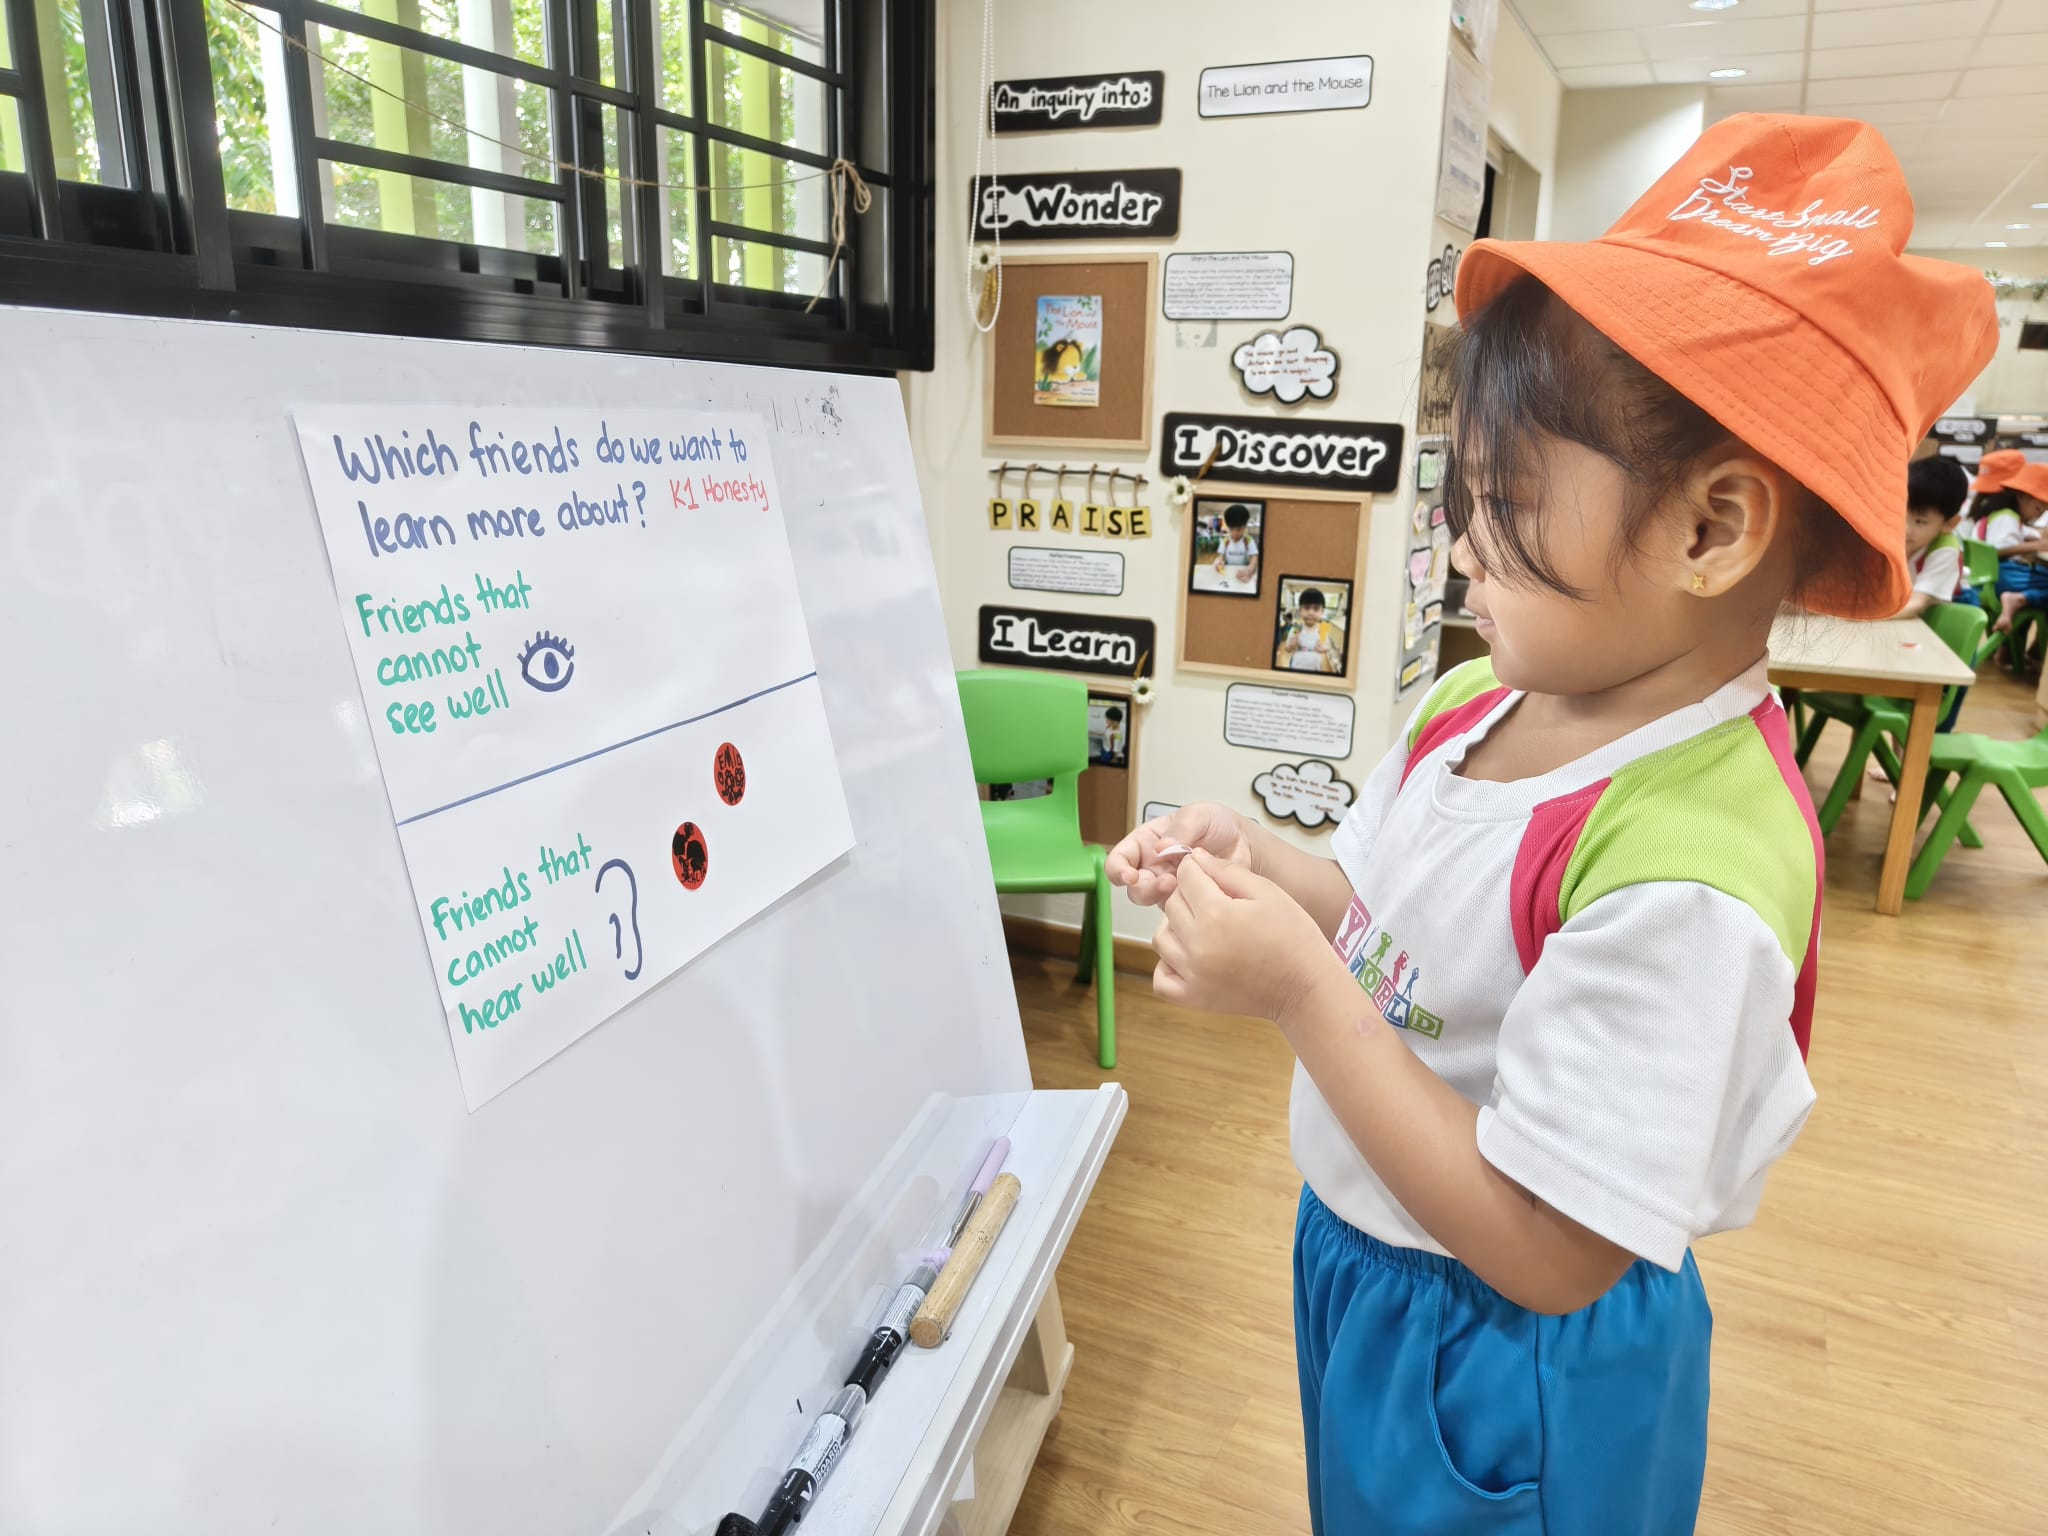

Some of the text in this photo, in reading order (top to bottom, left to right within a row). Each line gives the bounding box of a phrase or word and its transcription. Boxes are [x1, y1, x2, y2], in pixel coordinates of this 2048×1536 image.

[997, 82, 1149, 117] An inquiry into:
[1207, 76, 1363, 99] The Lion and the Mouse
[984, 184, 1159, 224] I Wonder
[1666, 188, 1854, 266] Dream Big
[333, 421, 748, 485] Which friends do we want to
[1178, 428, 1380, 472] I Discover
[357, 480, 647, 558] learn more about?
[668, 473, 769, 512] K1 Honesty
[992, 502, 1147, 536] PRAISE
[355, 569, 532, 638] Friends that
[376, 630, 483, 687] cannot
[992, 618, 1132, 662] I Learn
[385, 667, 510, 735] see well
[430, 832, 593, 941] Friends that
[447, 915, 540, 987] cannot
[458, 928, 588, 1035] hear well
